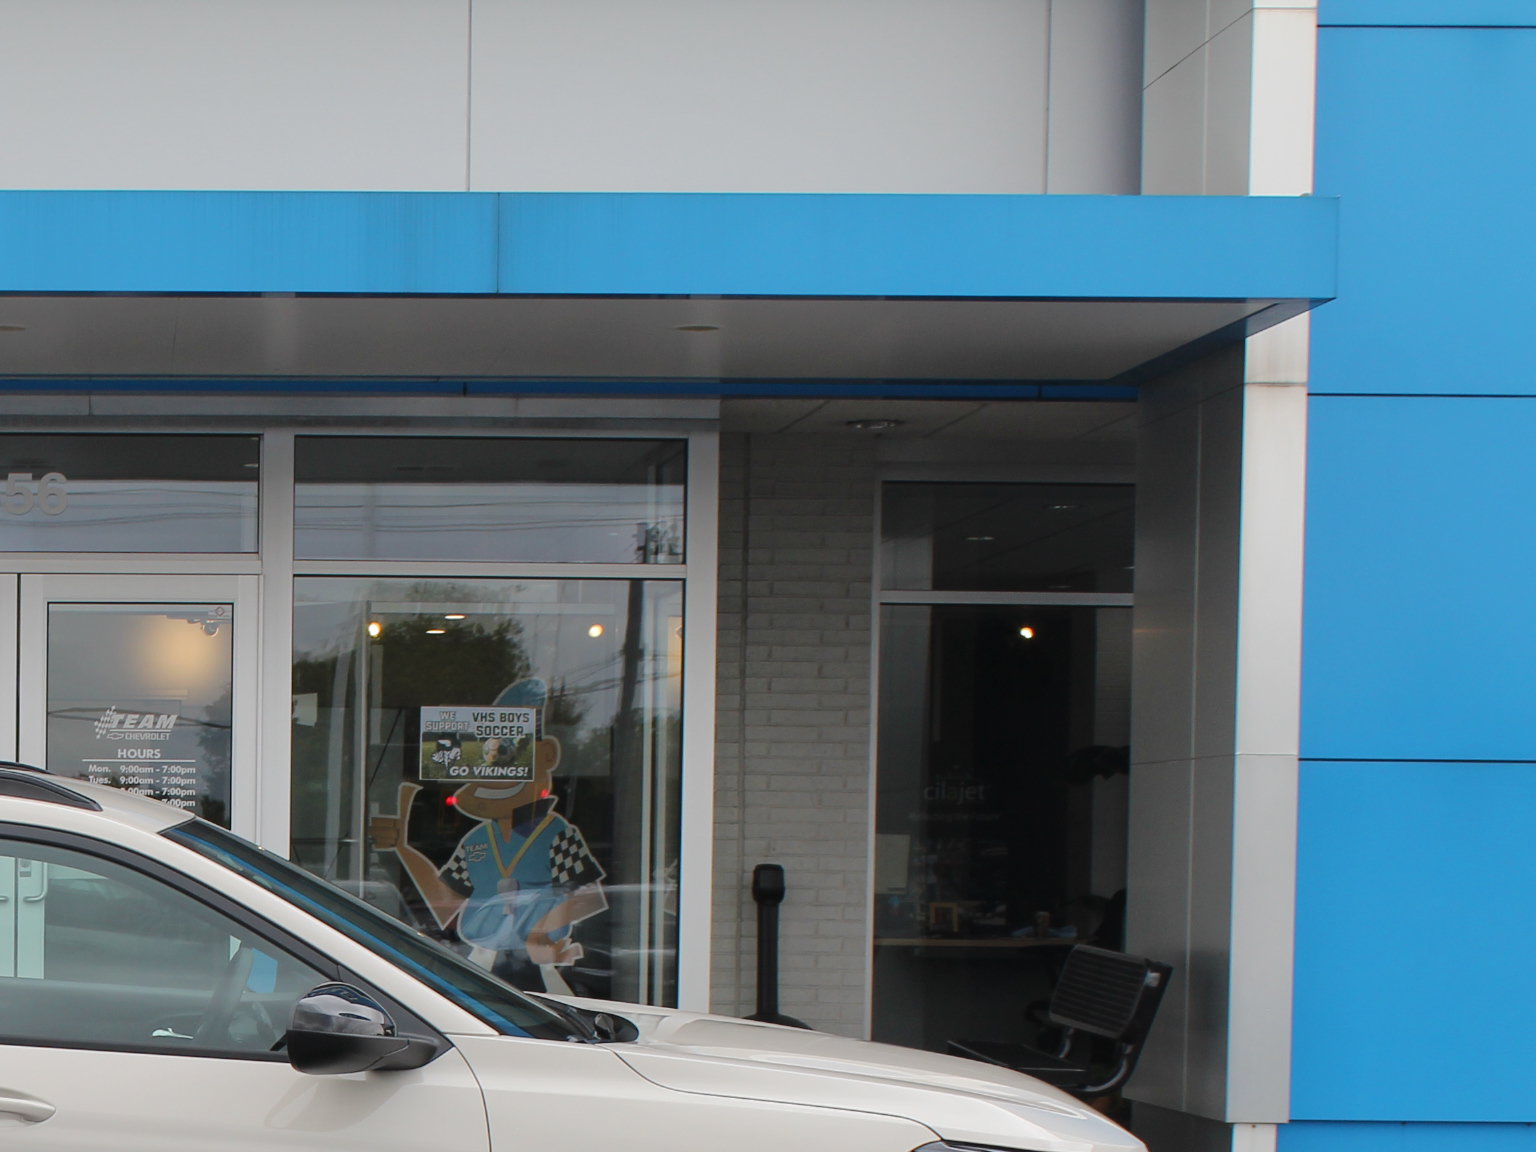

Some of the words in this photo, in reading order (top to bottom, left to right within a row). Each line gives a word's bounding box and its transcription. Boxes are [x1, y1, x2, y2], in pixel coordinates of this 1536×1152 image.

[439, 711, 456, 720] WE
[472, 712, 495, 723] VHS
[499, 712, 530, 723] BOYS
[110, 714, 178, 729] TEAM
[425, 721, 469, 731] SUPPORT
[124, 732, 171, 740] CHEVROLET
[475, 725, 525, 737] SOCCER
[117, 748, 161, 759] HOURS
[88, 764, 112, 773] Mon.
[120, 765, 154, 773] 9:00am
[161, 765, 196, 776] 7:00pm
[449, 766, 470, 776] GO
[473, 767, 529, 777] VIKINGS!
[120, 776, 154, 785] 9:00am
[161, 776, 196, 787] 7:00pm
[161, 787, 196, 798] 7:00pm
